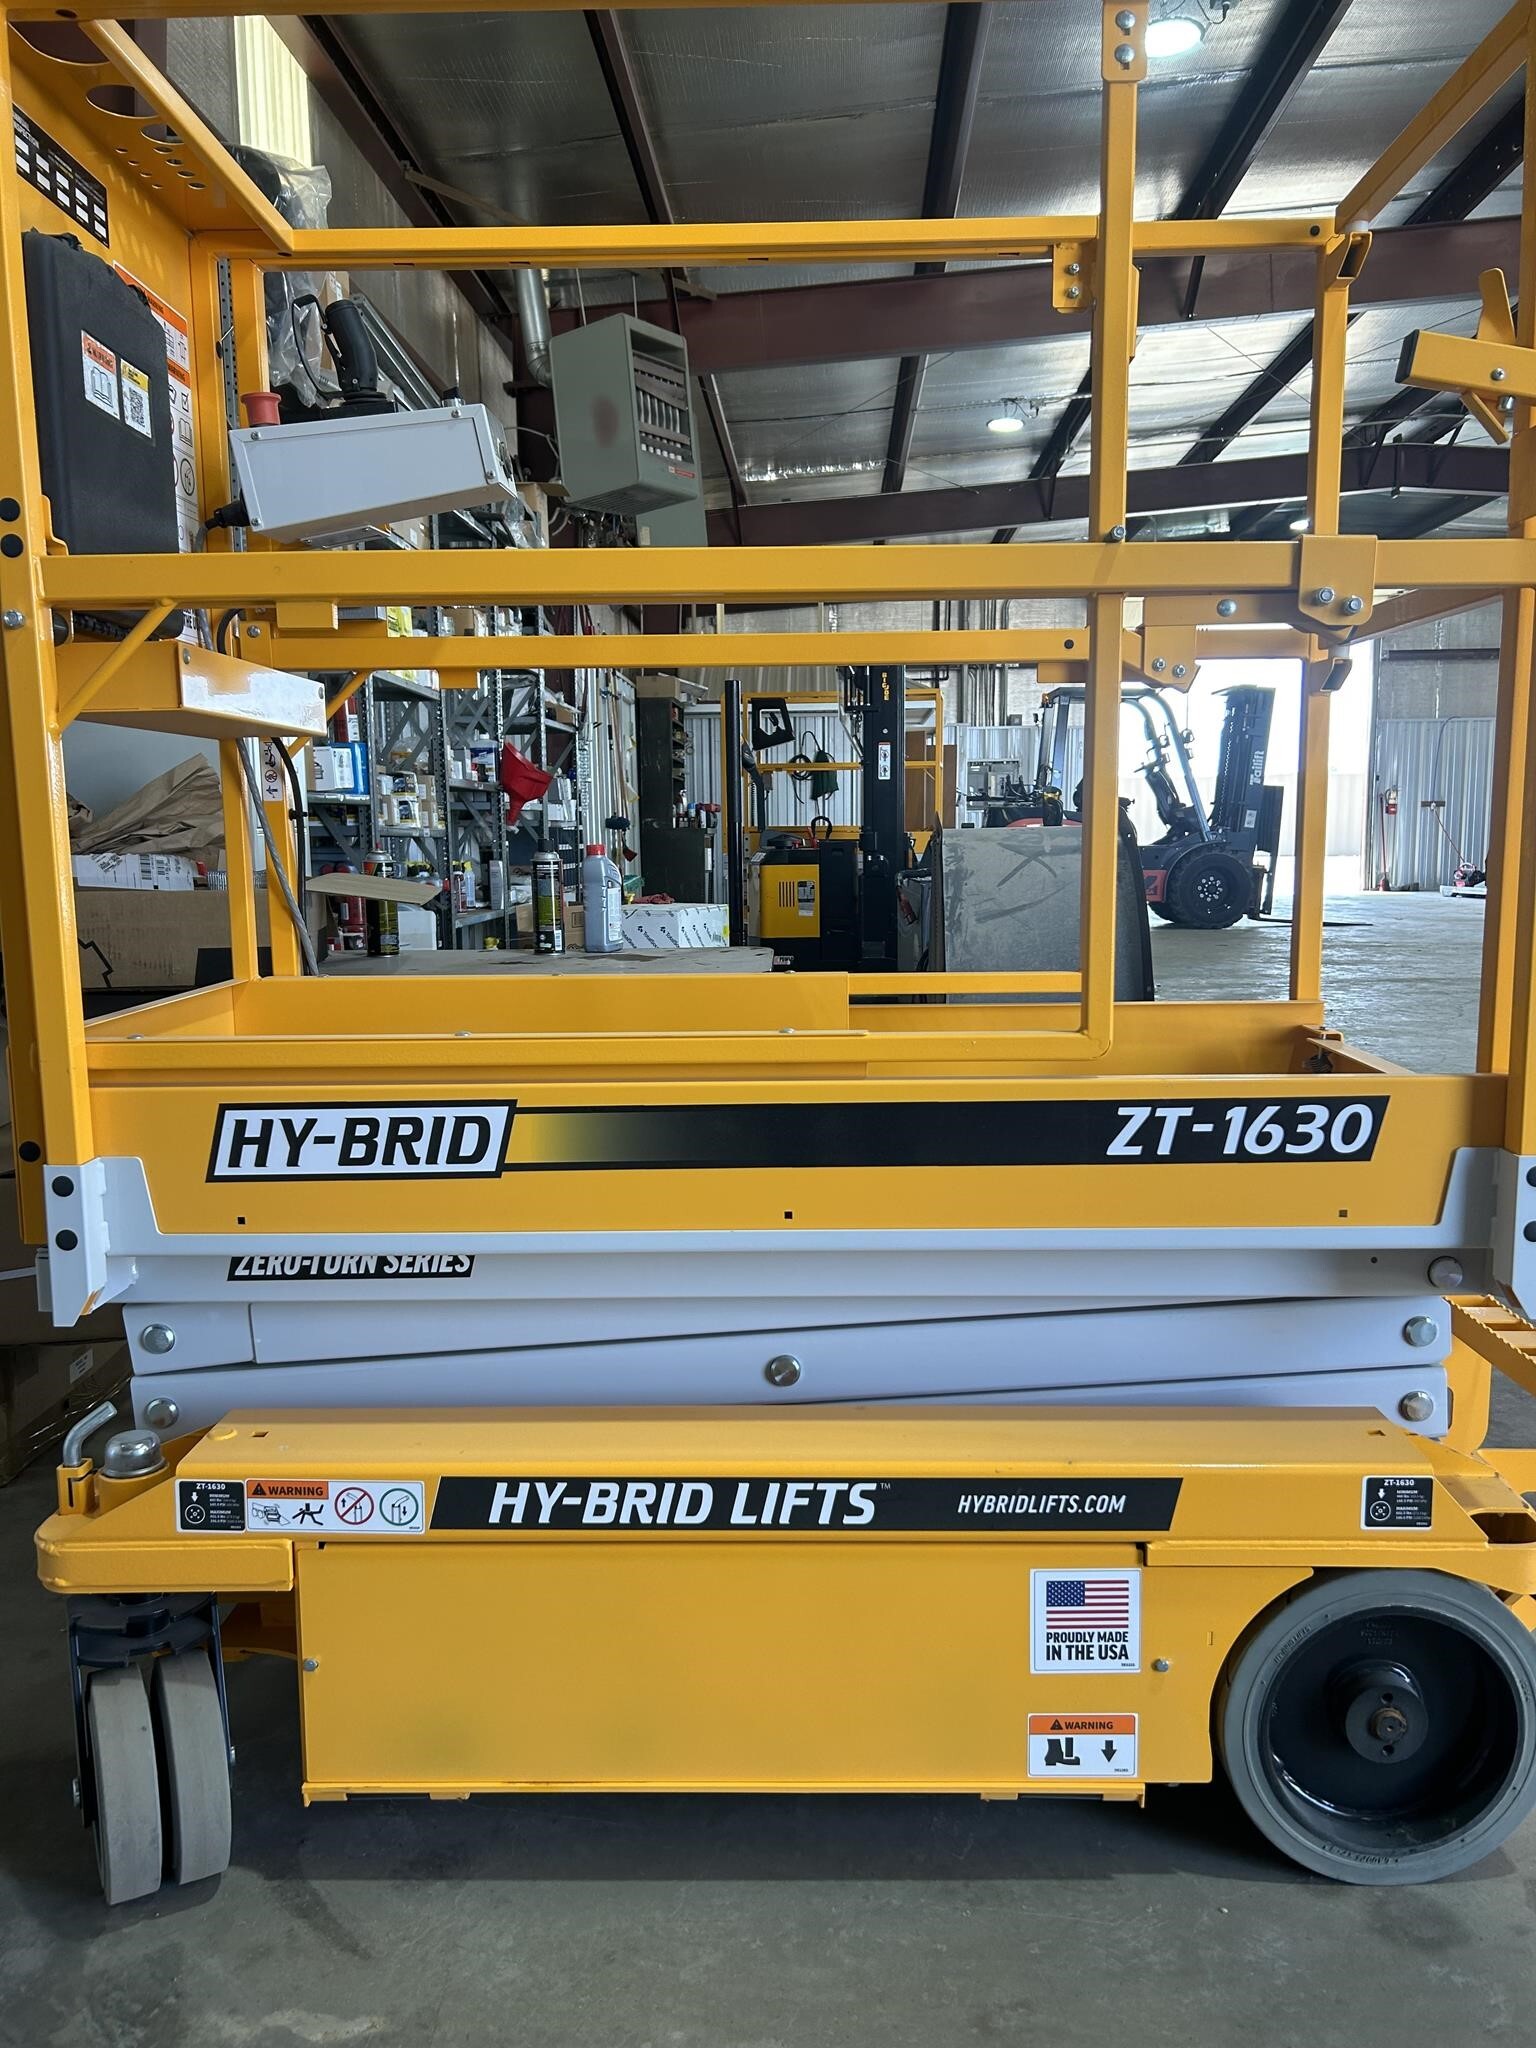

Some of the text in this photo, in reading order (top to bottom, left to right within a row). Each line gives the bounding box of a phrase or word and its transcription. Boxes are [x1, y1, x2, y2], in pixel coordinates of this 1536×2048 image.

[1106, 1103, 1374, 1156] ZT-1630
[227, 1115, 491, 1168] HY-BRID
[383, 1255, 471, 1275] SERIES
[268, 1485, 324, 1497] WARNING
[488, 1481, 714, 1524] HY-BRID
[729, 1481, 878, 1524] LIFTS
[957, 1494, 1126, 1514] HYBRIDLIFTS.COM
[1046, 1631, 1129, 1643] PROUDLY MADE
[1046, 1644, 1129, 1660] IN THE USA
[1064, 1721, 1114, 1730] WARNING
